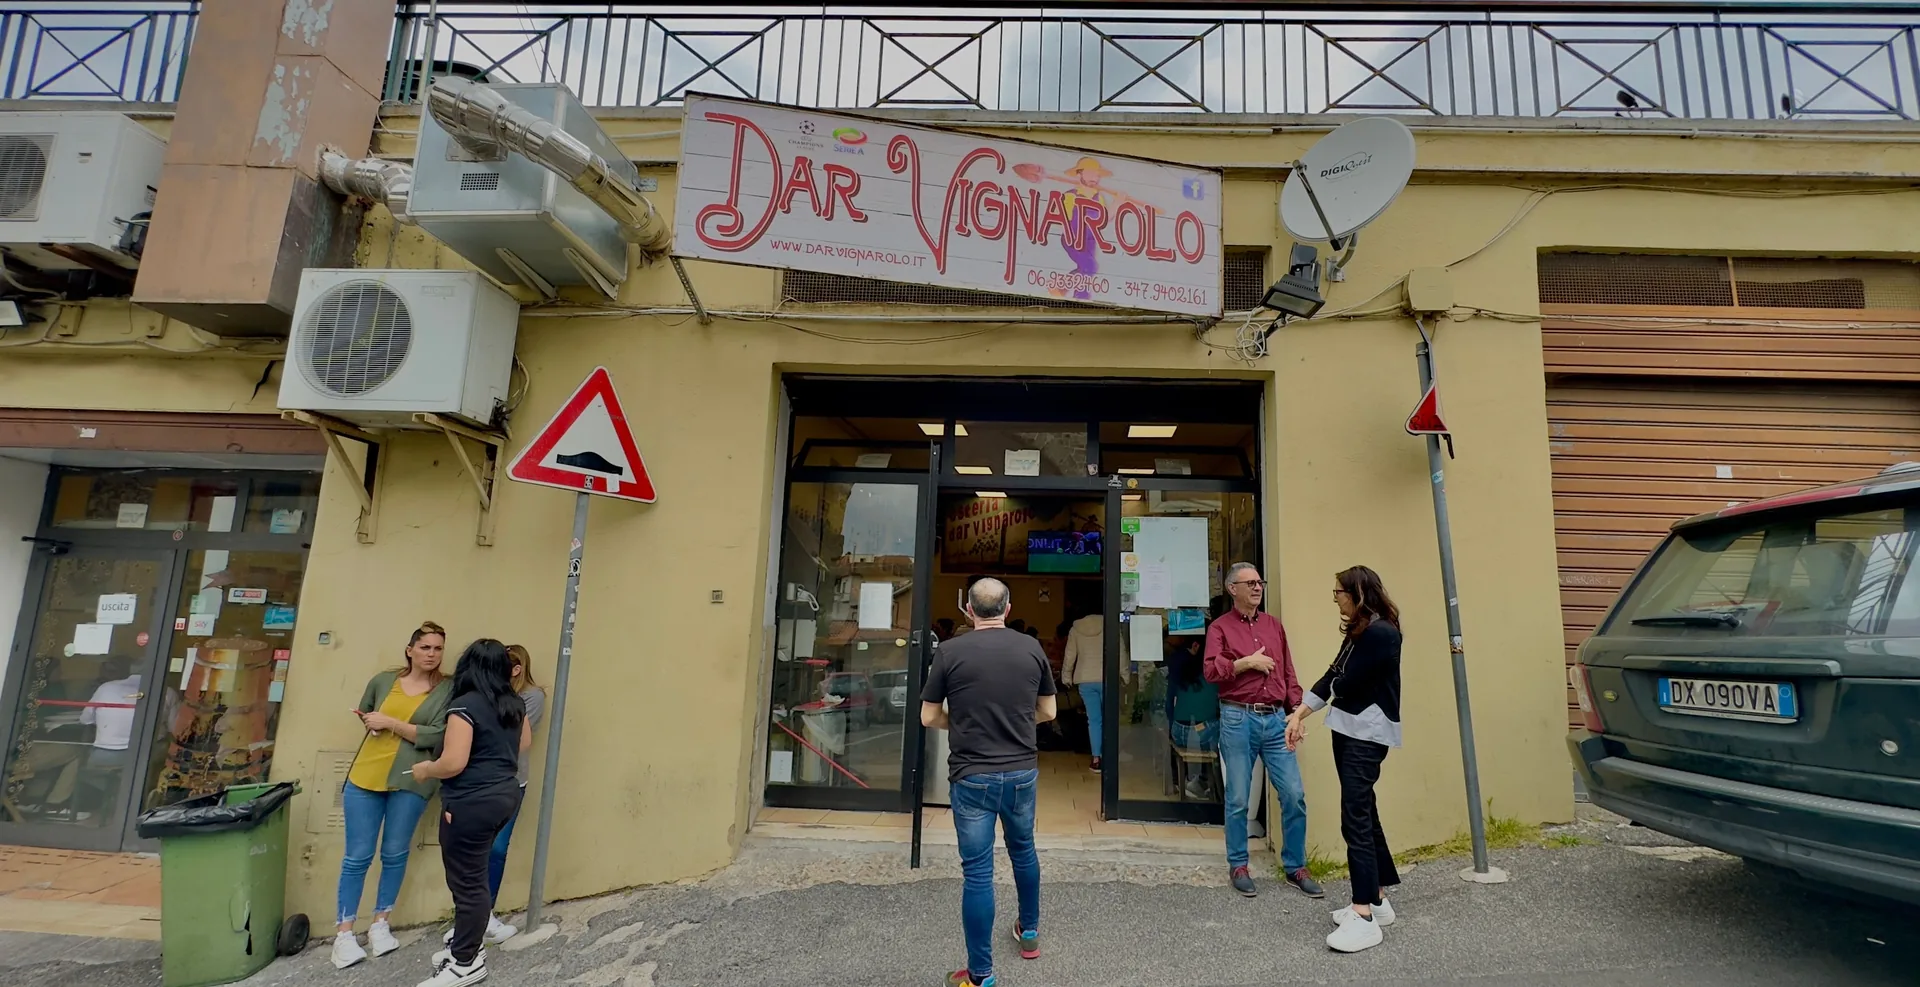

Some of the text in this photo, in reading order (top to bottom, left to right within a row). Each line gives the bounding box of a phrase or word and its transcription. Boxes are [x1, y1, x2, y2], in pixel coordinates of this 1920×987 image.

[834, 143, 864, 155] SERIE A
[696, 112, 1205, 285] DAR VIGNAROLO
[949, 522, 970, 542] dar
[101, 602, 130, 611] uscita
[1670, 680, 1776, 711] DX 090VA
